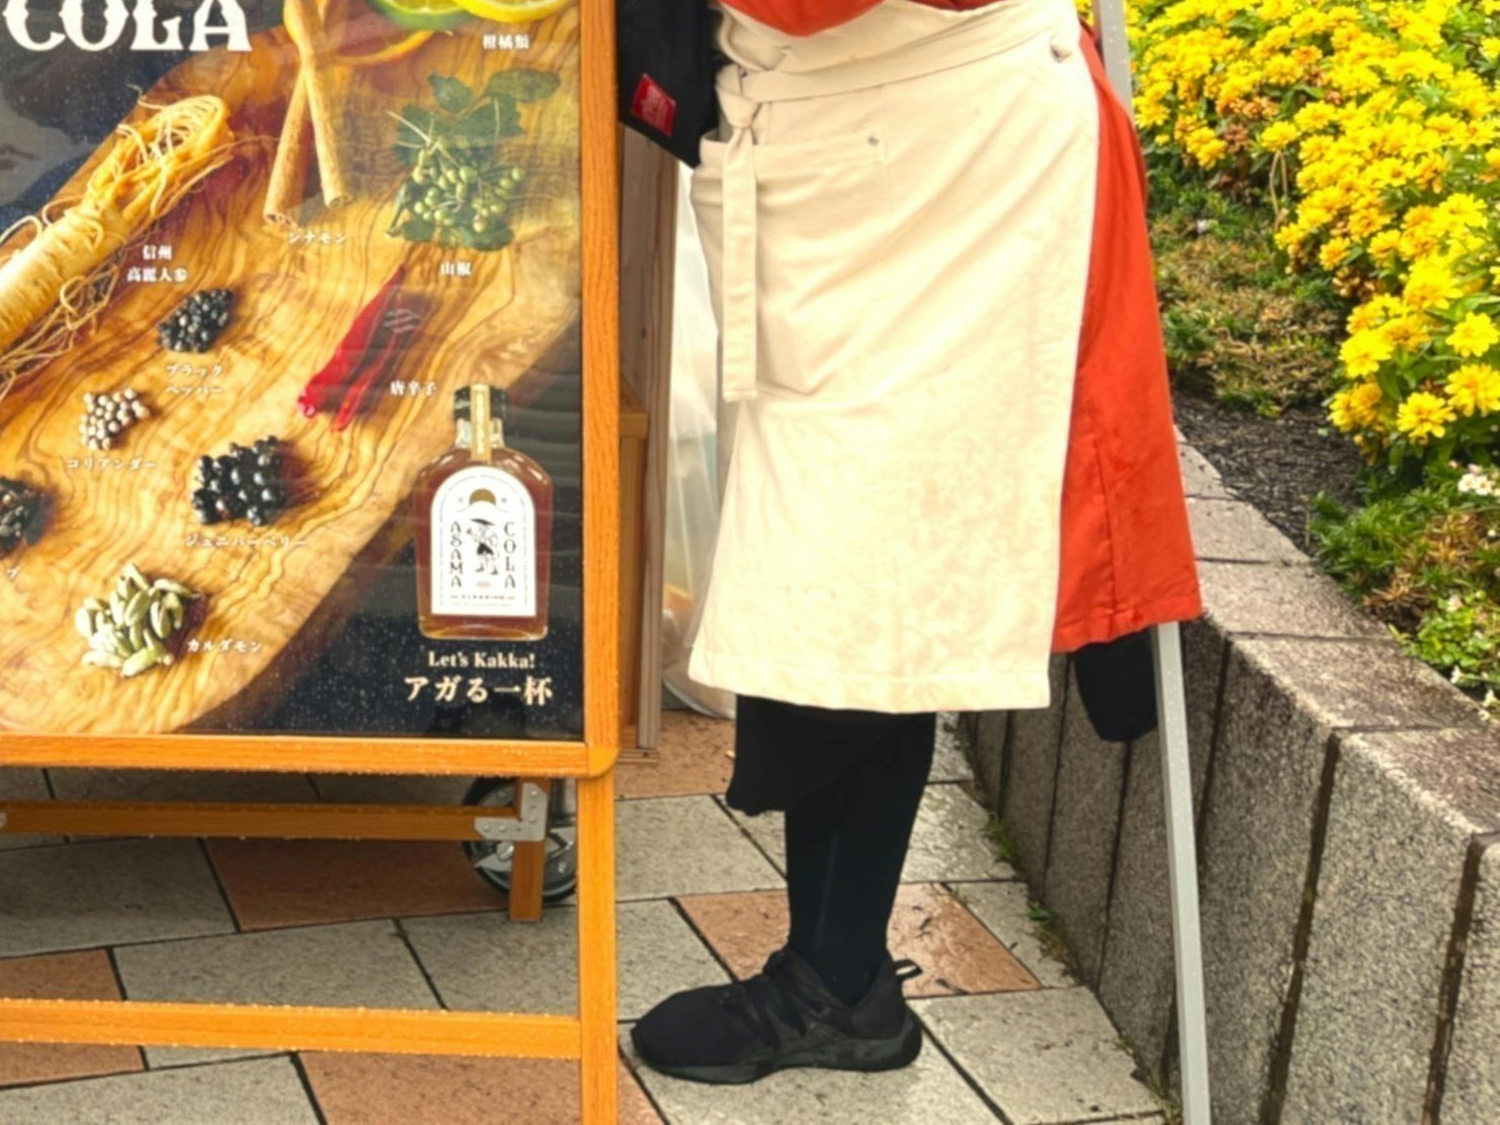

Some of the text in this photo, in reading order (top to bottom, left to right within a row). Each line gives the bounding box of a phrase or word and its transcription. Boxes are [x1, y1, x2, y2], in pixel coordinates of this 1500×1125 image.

[287, 230, 347, 245] シナモン
[142, 244, 173, 261] 信州
[440, 261, 472, 276] 山椒
[165, 362, 223, 376] ブラック
[389, 379, 437, 395] 唐辛子
[67, 457, 158, 470] コリアンダー
[449, 520, 463, 588] ASAMA
[503, 521, 517, 589] COLA
[187, 637, 262, 653] カルダモン
[428, 650, 536, 669] Let's Kakka!
[403, 675, 553, 706] アガる一杯
